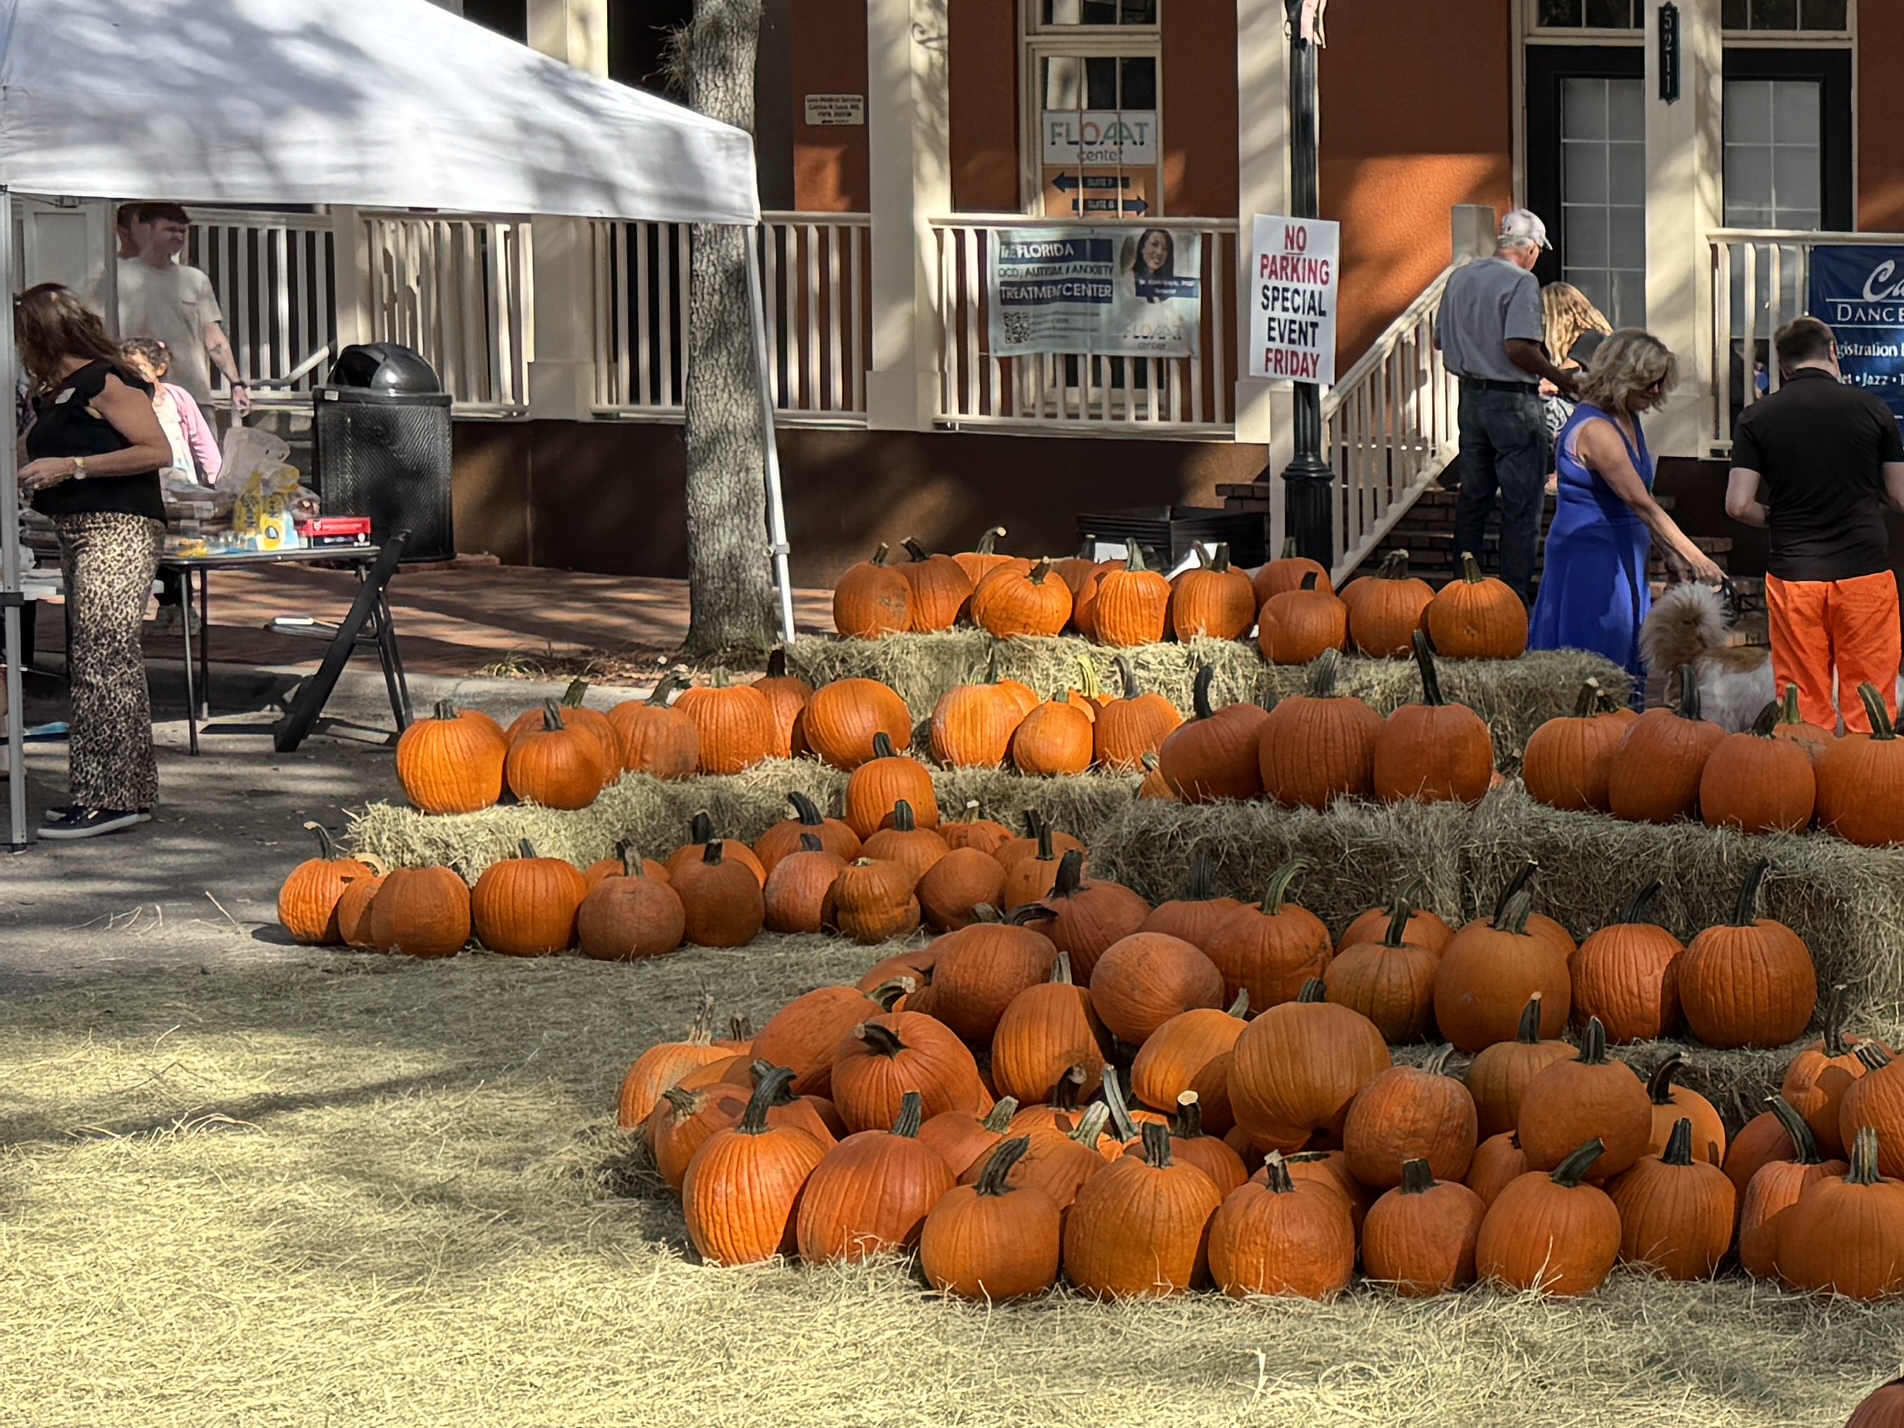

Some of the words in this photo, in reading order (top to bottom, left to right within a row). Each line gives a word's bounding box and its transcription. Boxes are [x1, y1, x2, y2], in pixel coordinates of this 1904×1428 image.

[1663, 11, 1673, 93] 5211
[1050, 121, 1149, 146] FLOAAT
[1016, 242, 1075, 259] FLORIDA
[1284, 224, 1308, 253] NO
[1259, 253, 1330, 286] PARKING
[1062, 283, 1113, 298] CENTER
[1260, 284, 1328, 318] SPECIAL
[1266, 316, 1320, 348] EVENT
[1264, 348, 1321, 380] FRIDAY
[1861, 373, 1889, 387] Jazz
